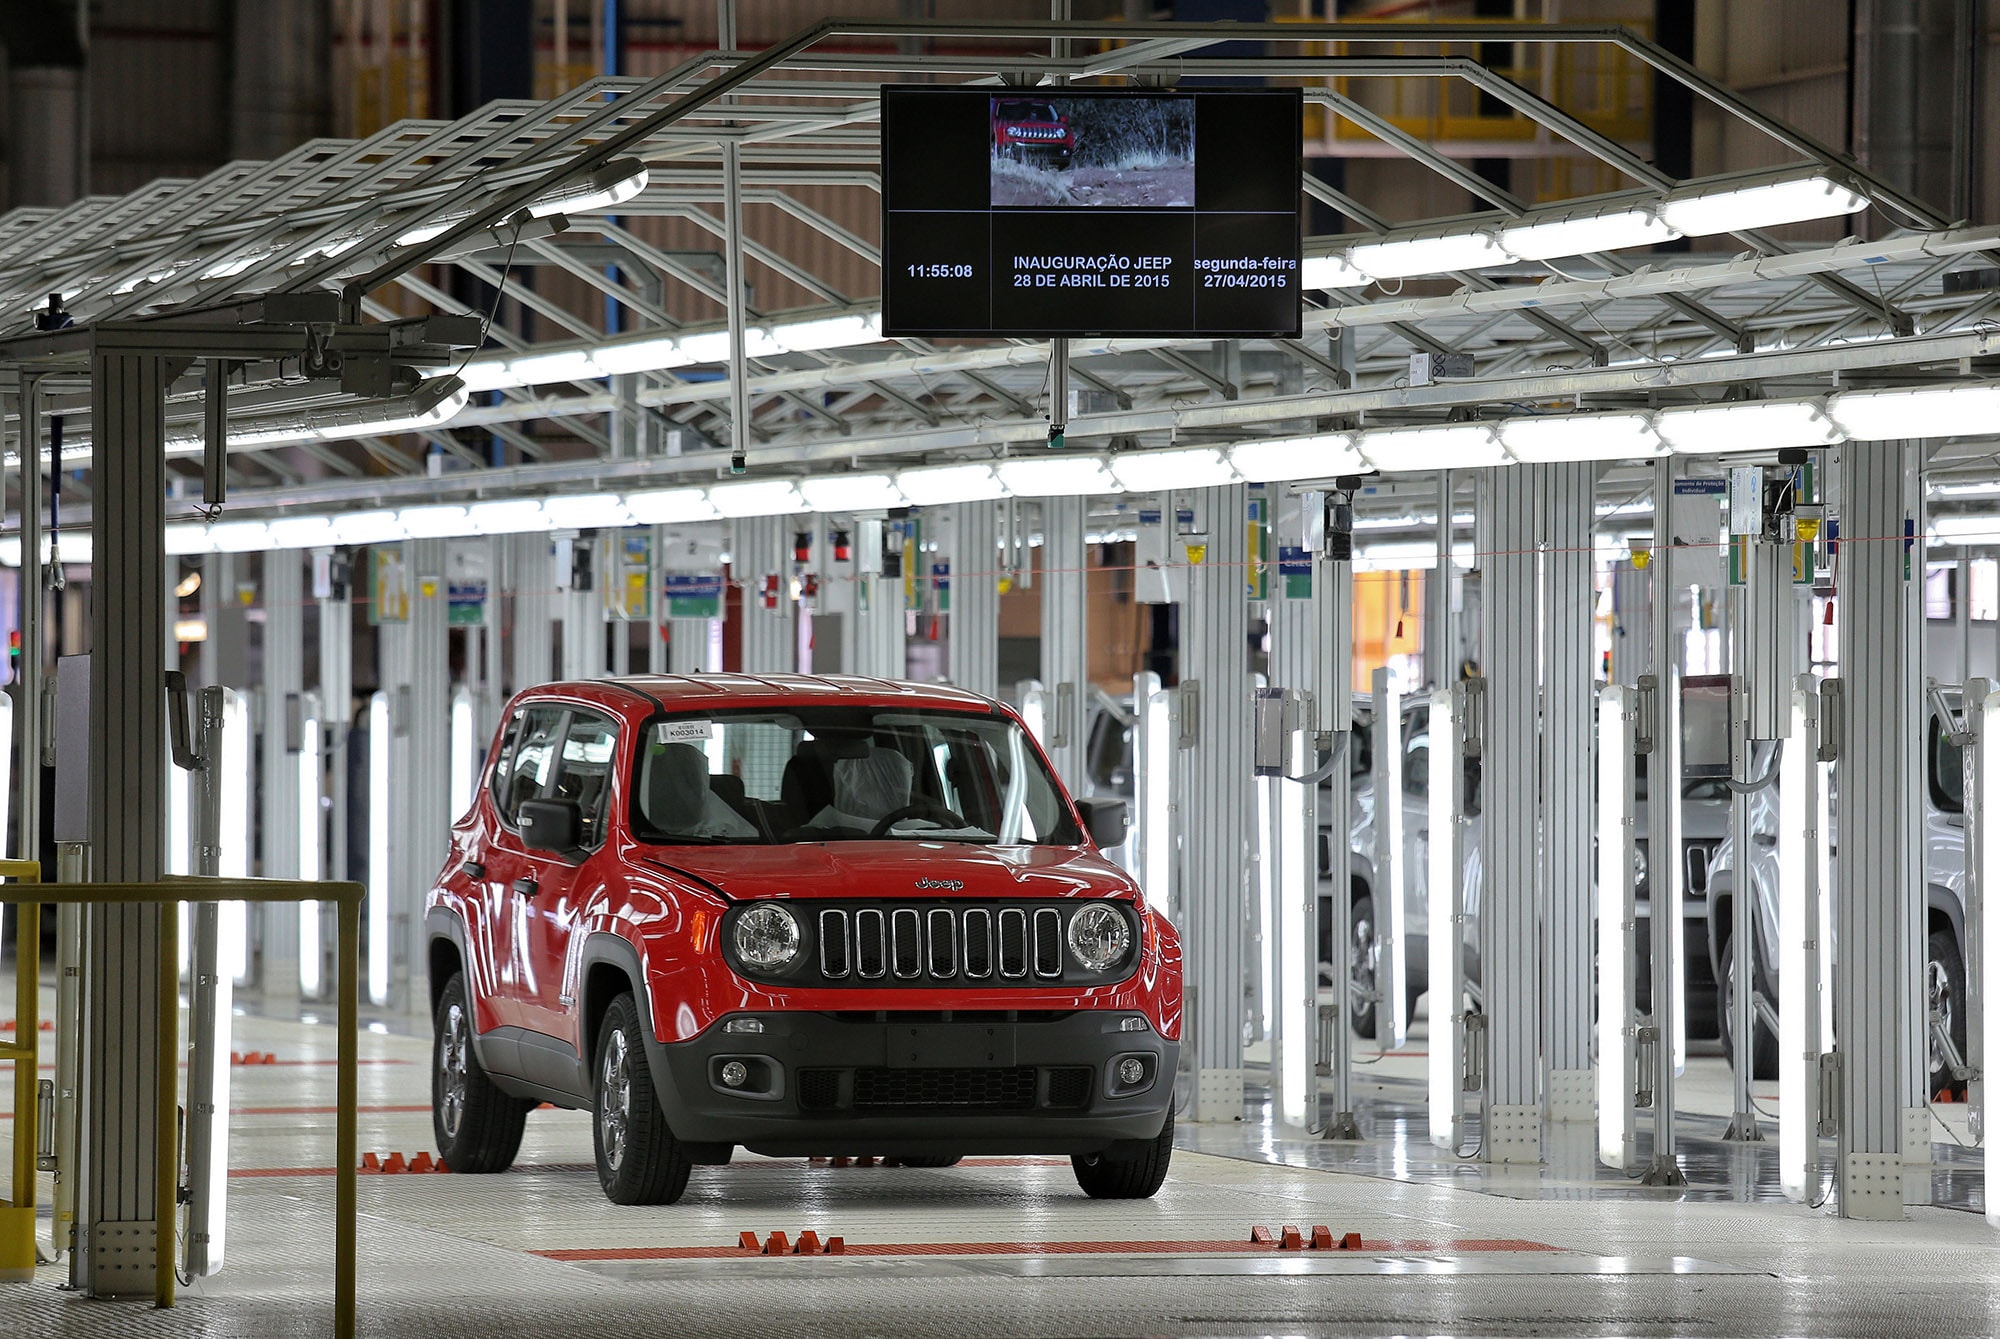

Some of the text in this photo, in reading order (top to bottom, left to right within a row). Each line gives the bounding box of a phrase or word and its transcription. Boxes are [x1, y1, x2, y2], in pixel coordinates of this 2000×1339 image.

[1013, 253, 1172, 272] INAUGURAÇÃO JEEP
[1194, 256, 1296, 273] segunda-feira
[907, 264, 973, 278] 11:55:08
[1013, 274, 1170, 288] 28 DE ABRIL DE 2015
[1204, 274, 1287, 288] 27/04/2015
[915, 876, 964, 891] Jeep
